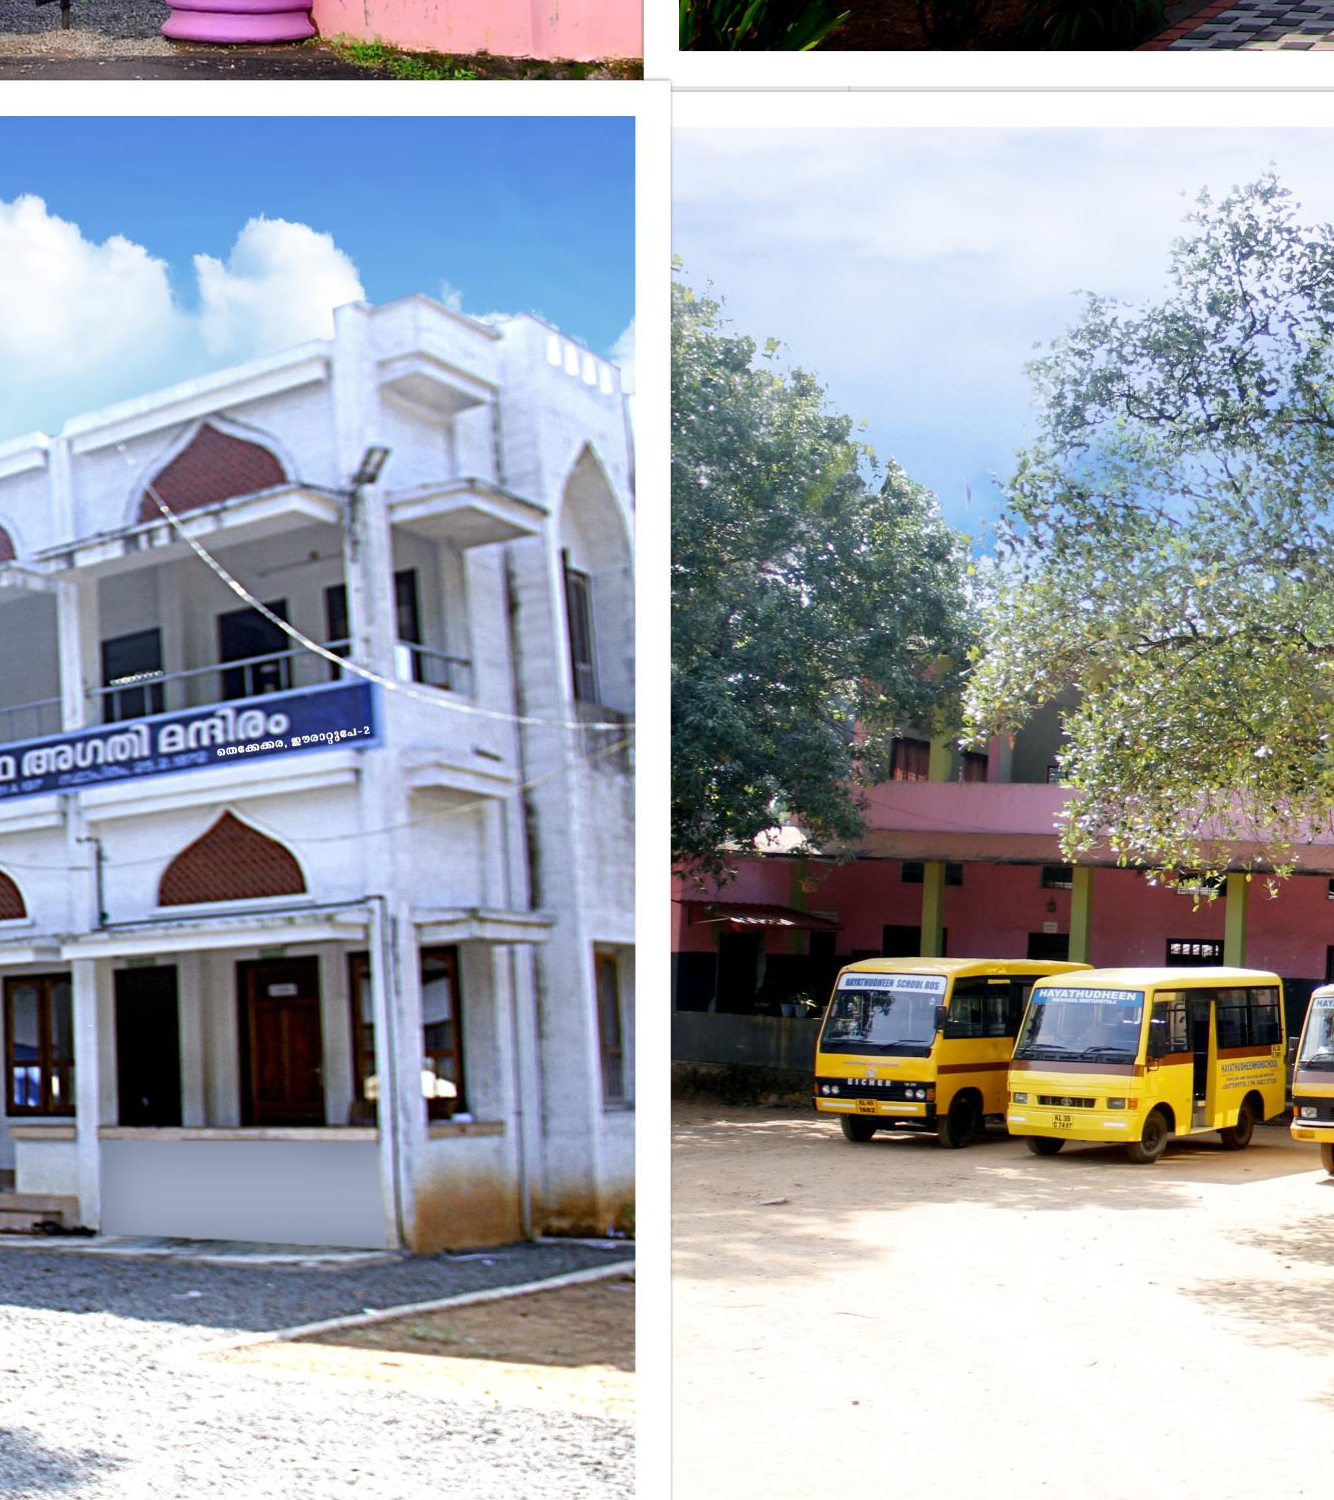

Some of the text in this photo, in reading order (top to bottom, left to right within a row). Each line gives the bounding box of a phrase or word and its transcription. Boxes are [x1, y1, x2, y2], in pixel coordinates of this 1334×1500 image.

[896, 979, 924, 989] SCHOOL
[924, 981, 940, 990] BUS
[1039, 988, 1137, 1001] HAYATHUDHEEN
[847, 1077, 892, 1087] EICHER
